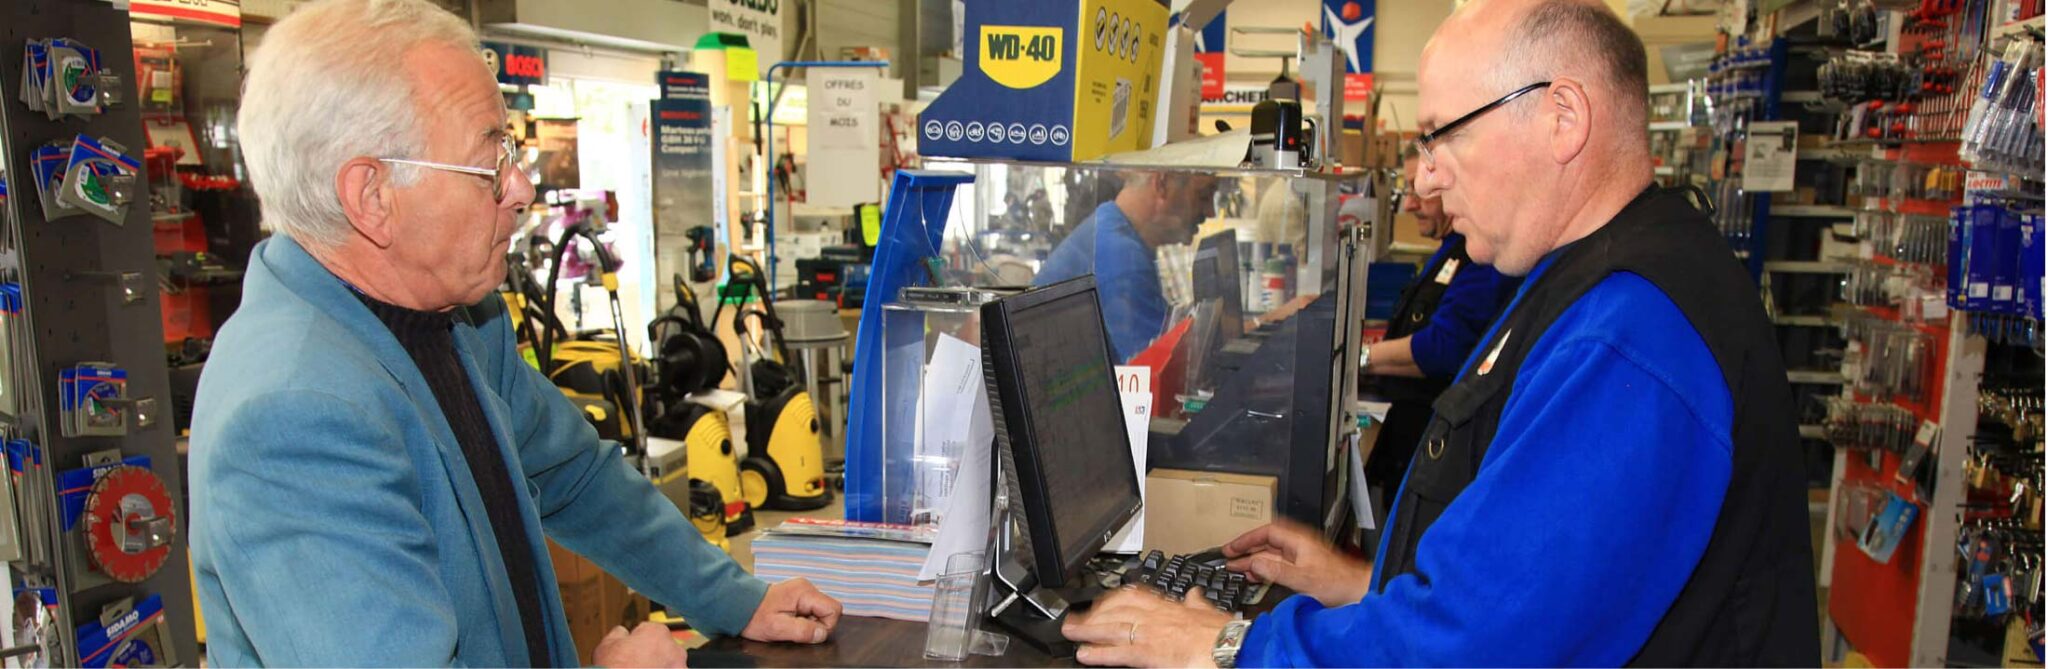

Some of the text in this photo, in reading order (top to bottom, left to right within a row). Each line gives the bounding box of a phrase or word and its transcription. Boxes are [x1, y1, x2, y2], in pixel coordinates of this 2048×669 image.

[824, 80, 865, 90] OFFRES
[836, 97, 852, 107] DU
[829, 117, 859, 127] MOIS
[92, 463, 127, 479] SID
[106, 610, 139, 638] SIDAMO
